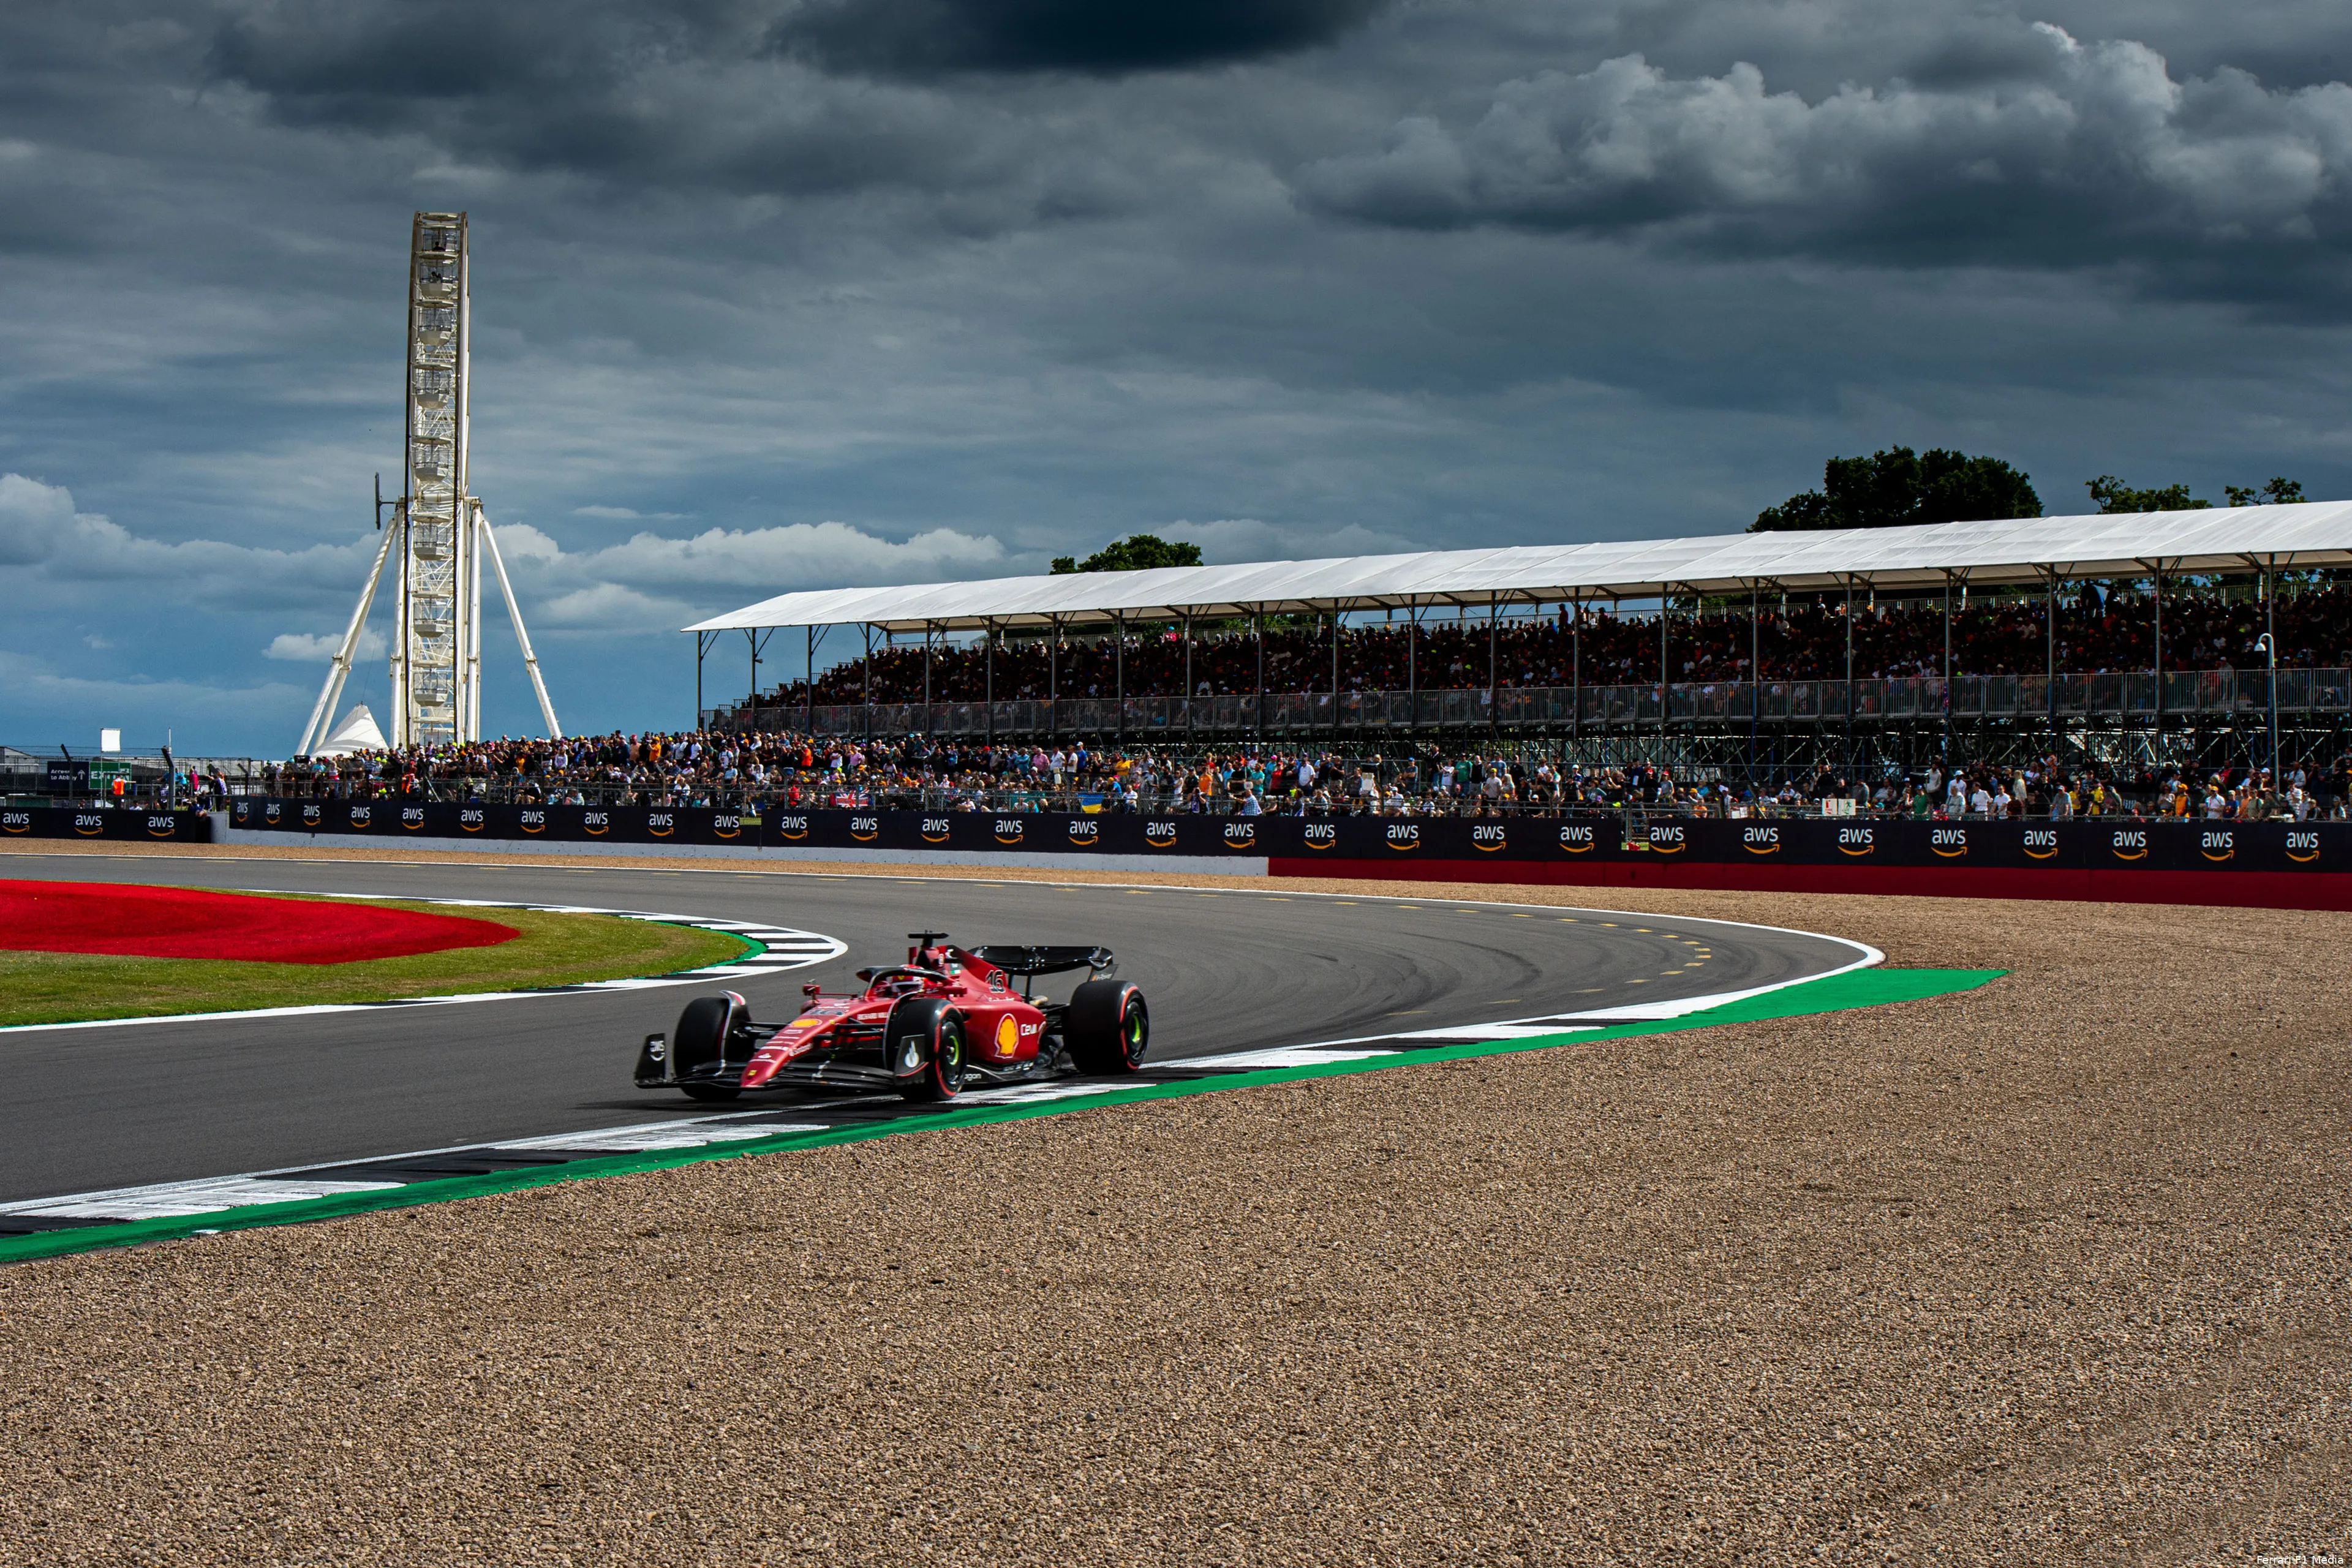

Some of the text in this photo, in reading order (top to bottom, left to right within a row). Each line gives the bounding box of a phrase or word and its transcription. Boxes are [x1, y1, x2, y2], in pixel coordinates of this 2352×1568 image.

[237, 802, 248, 813] aws
[266, 804, 280, 815] aws
[304, 805, 320, 816] aws
[351, 807, 370, 818] aws
[402, 808, 423, 820] aws
[3, 813, 29, 824] aws
[75, 815, 102, 826] aws
[148, 816, 174, 827] aws
[461, 810, 483, 822] aws
[521, 811, 545, 823] aws
[585, 812, 608, 824] aws
[649, 813, 673, 826] aws
[715, 815, 739, 828] aws
[782, 816, 807, 829] aws
[851, 817, 878, 831] aws
[922, 818, 949, 832] aws
[995, 820, 1022, 833] aws
[1069, 821, 1098, 834] aws
[1147, 822, 1175, 836] aws
[1225, 823, 1254, 837] aws
[1305, 824, 1335, 838] aws
[1387, 824, 1419, 839] aws
[1474, 826, 1505, 840] aws
[1561, 826, 1593, 841] aws
[1651, 827, 1684, 841] aws
[1744, 827, 1778, 842] aws
[1839, 828, 1873, 843] aws
[1932, 829, 1966, 844] aws
[2024, 830, 2057, 846] aws
[2114, 831, 2146, 847] aws
[2203, 832, 2233, 848] aws
[2287, 832, 2318, 848] aws
[985, 970, 1005, 993] 16
